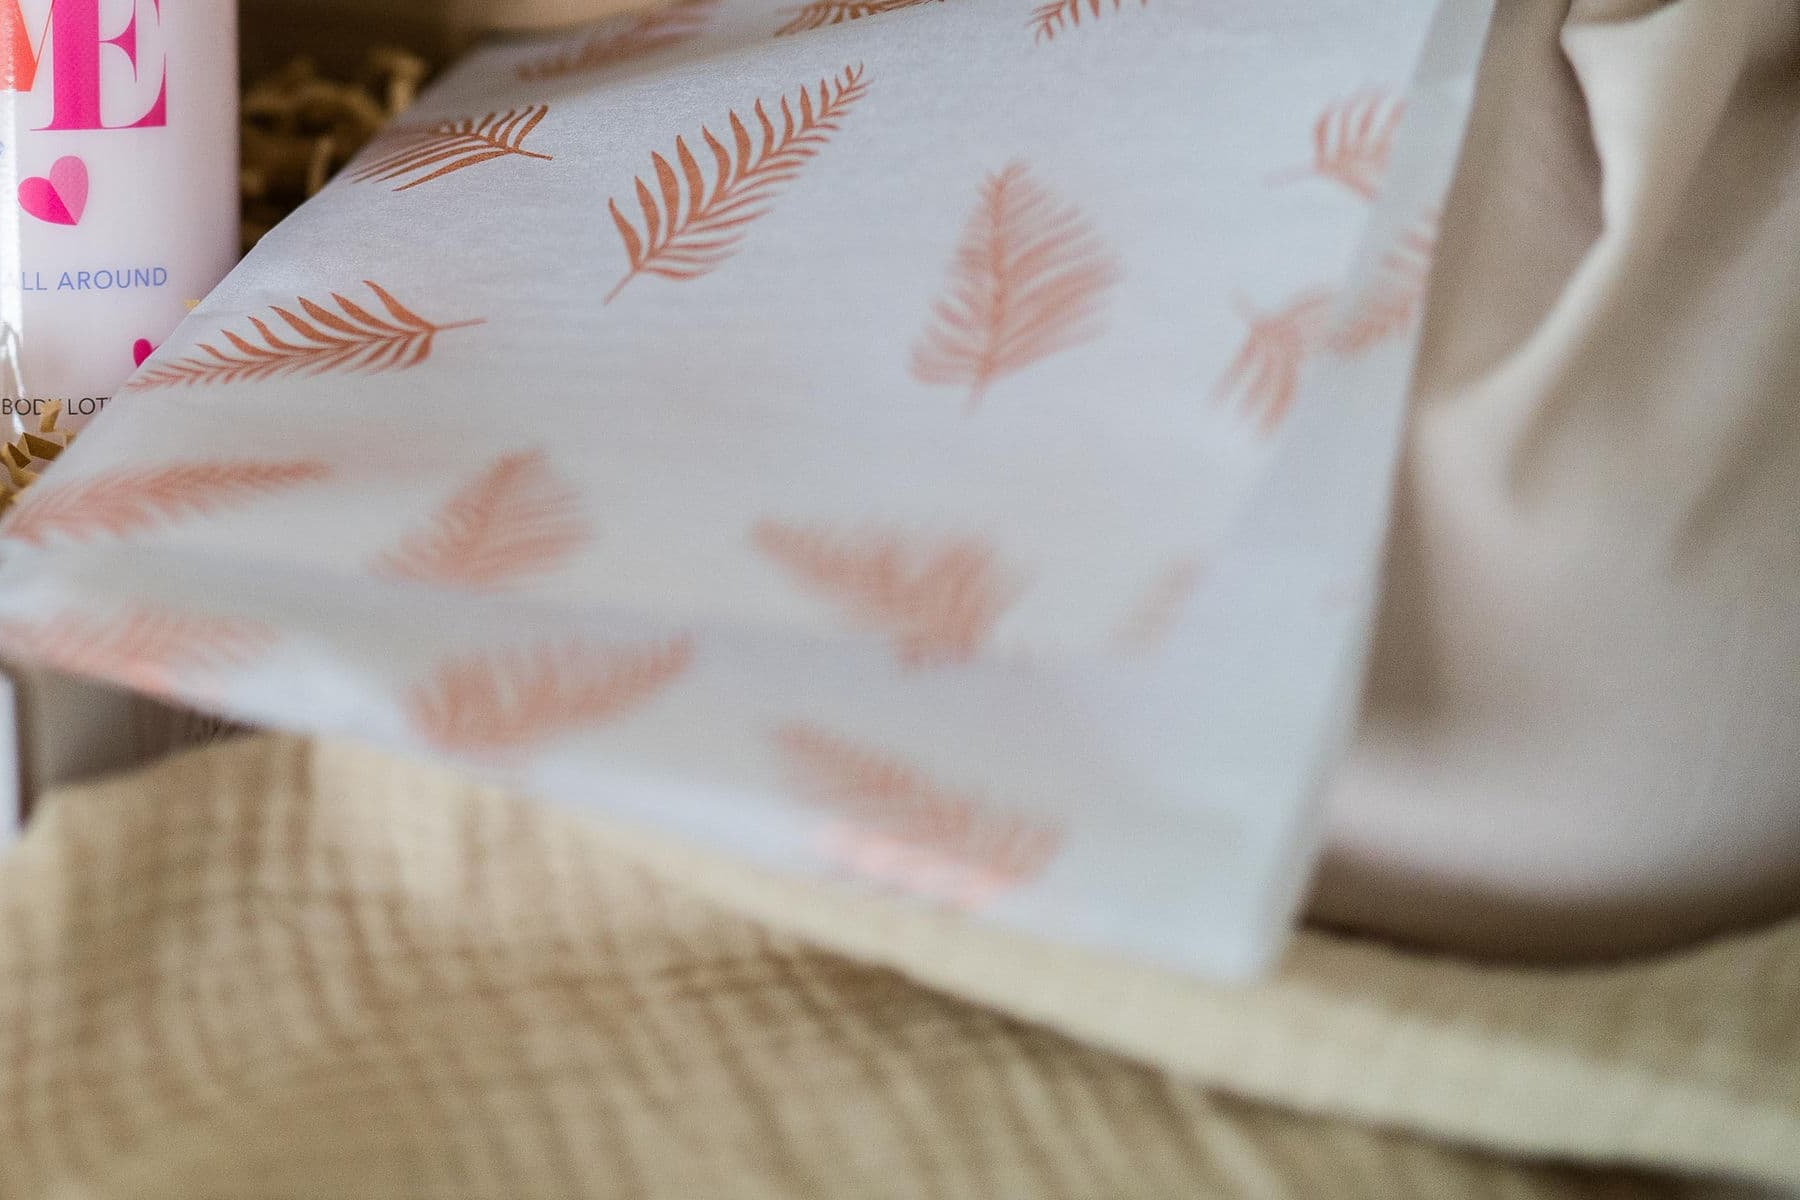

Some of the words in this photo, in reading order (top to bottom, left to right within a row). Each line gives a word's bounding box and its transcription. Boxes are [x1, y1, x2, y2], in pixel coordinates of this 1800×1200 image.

[8, 271, 47, 290] LL
[57, 267, 167, 290] AROUND
[2, 398, 61, 416] BOD
[68, 397, 112, 416] LOT
